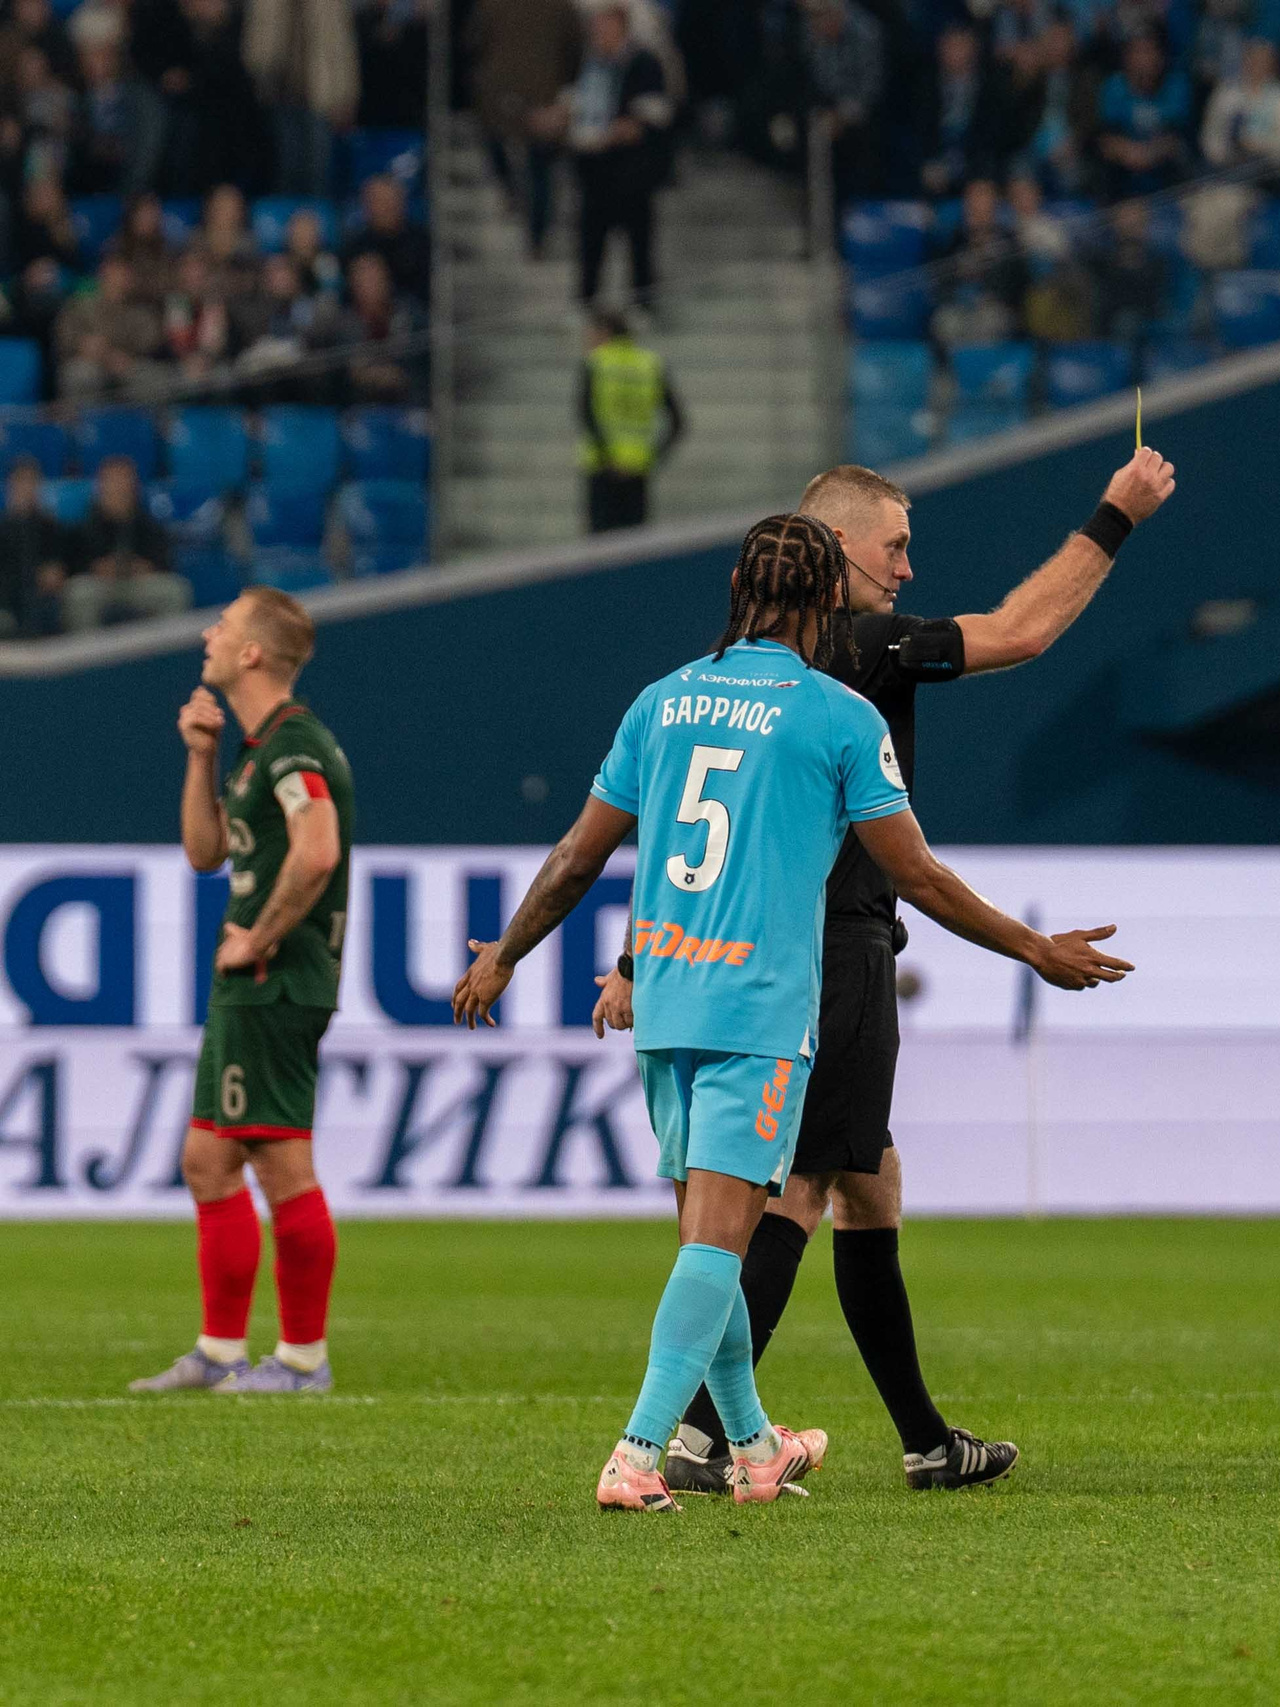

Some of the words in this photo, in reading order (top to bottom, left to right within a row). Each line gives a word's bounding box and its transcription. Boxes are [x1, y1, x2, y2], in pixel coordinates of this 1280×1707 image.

[697, 673, 775, 687] АЭРОФЛОТ
[662, 695, 782, 735] БАРРИОС
[666, 744, 745, 893] 5
[221, 1064, 246, 1120] 6
